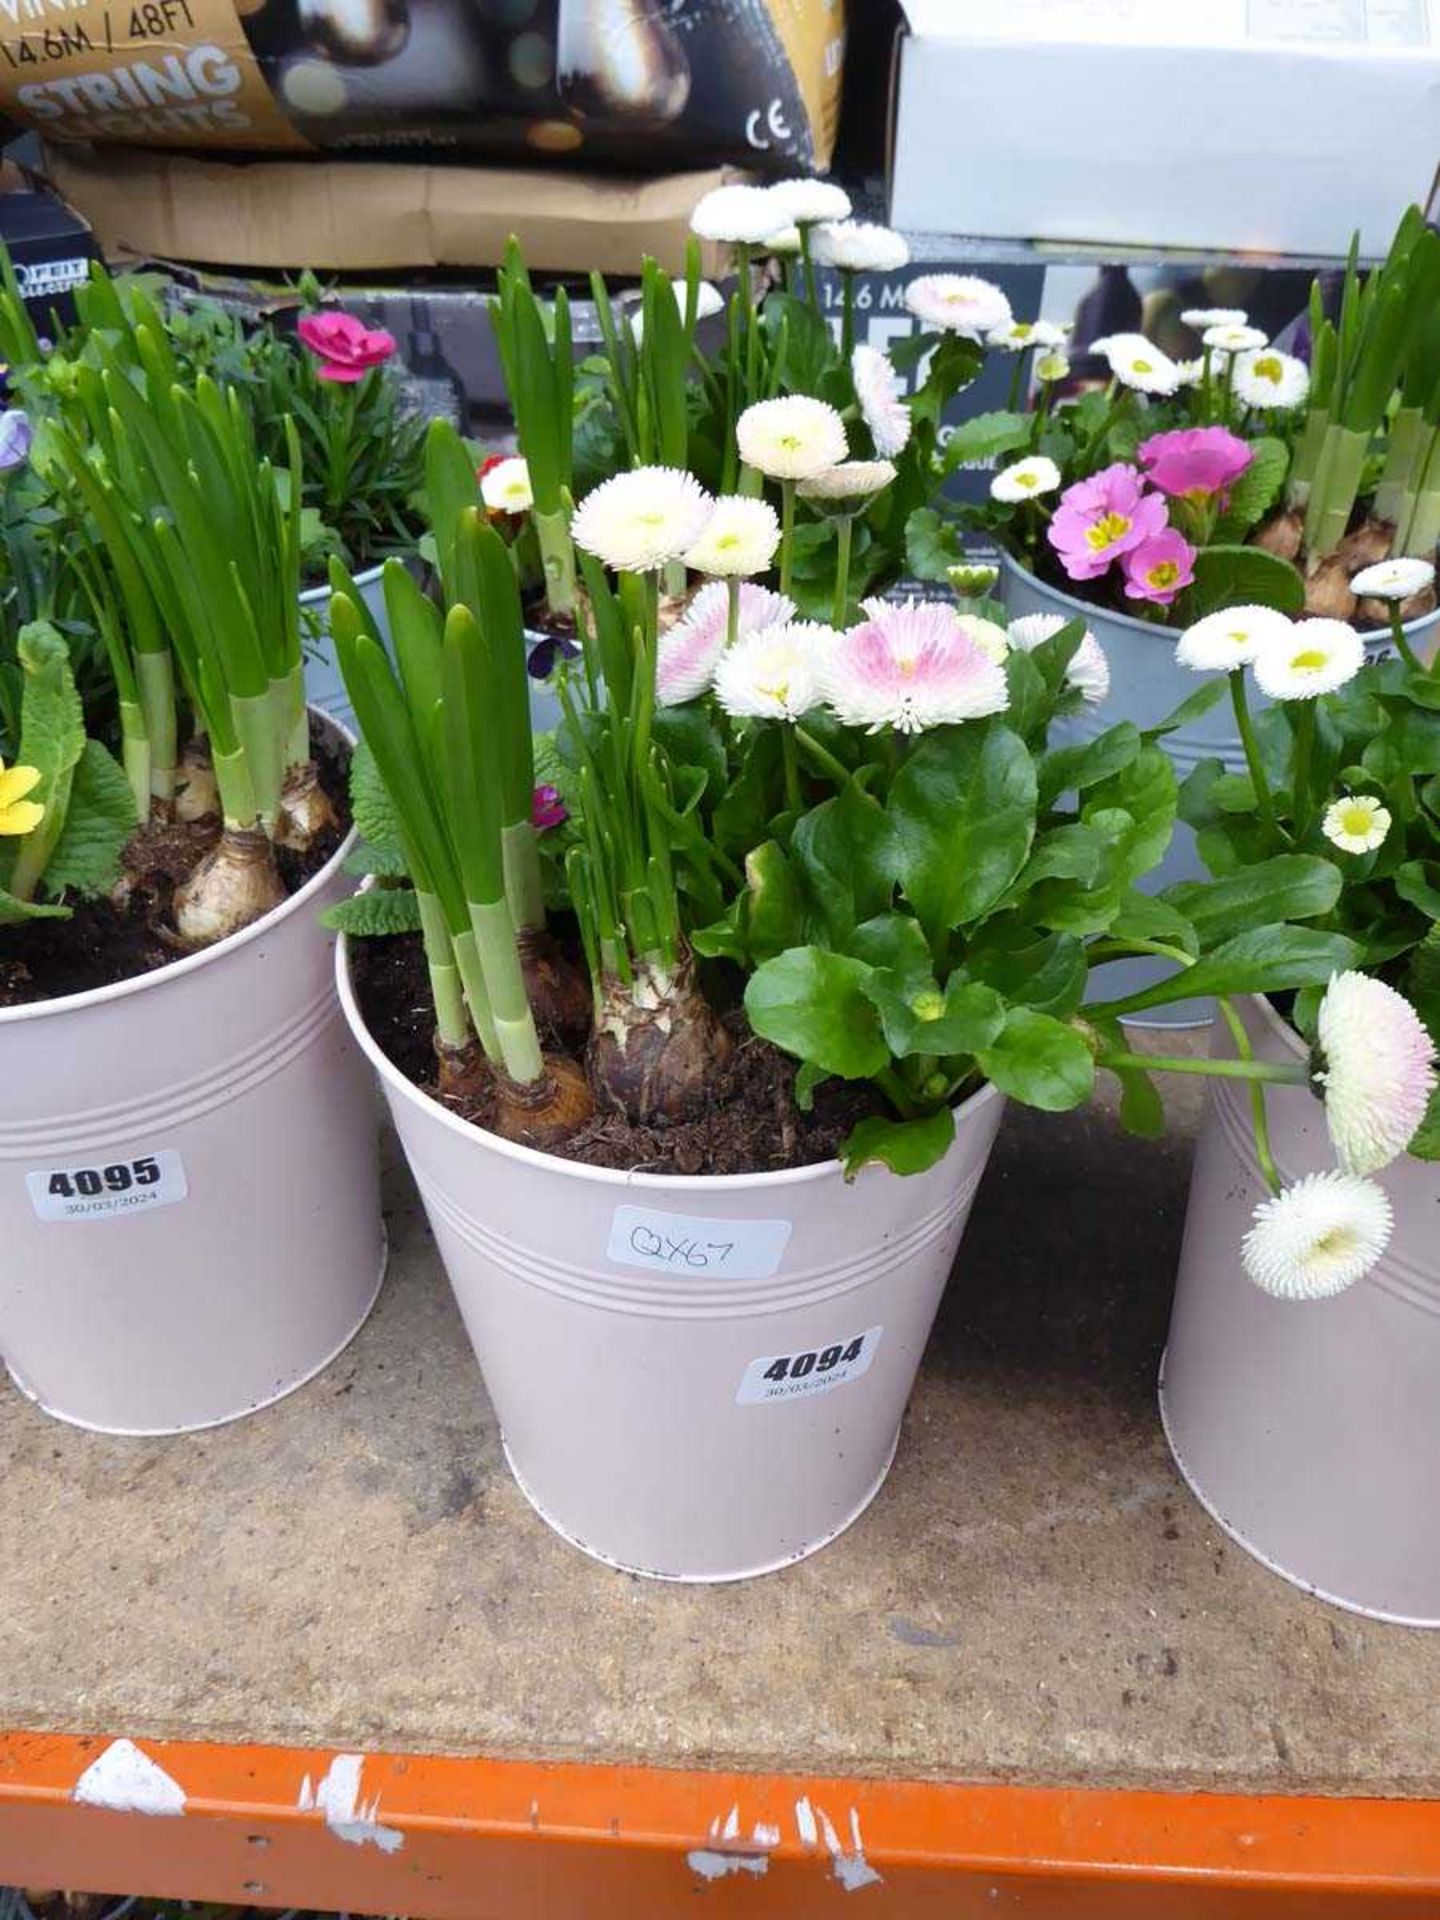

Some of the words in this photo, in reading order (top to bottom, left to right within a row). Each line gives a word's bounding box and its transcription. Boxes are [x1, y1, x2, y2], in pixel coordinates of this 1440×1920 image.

[2, 21, 95, 68] 14.6M
[129, 0, 195, 39] 48FT
[17, 44, 241, 119] STRING
[49, 1157, 161, 1197] 4095
[65, 1191, 157, 1216] 30/03/2024
[631, 1226, 733, 1267] QX67
[763, 1335, 865, 1381] 4094
